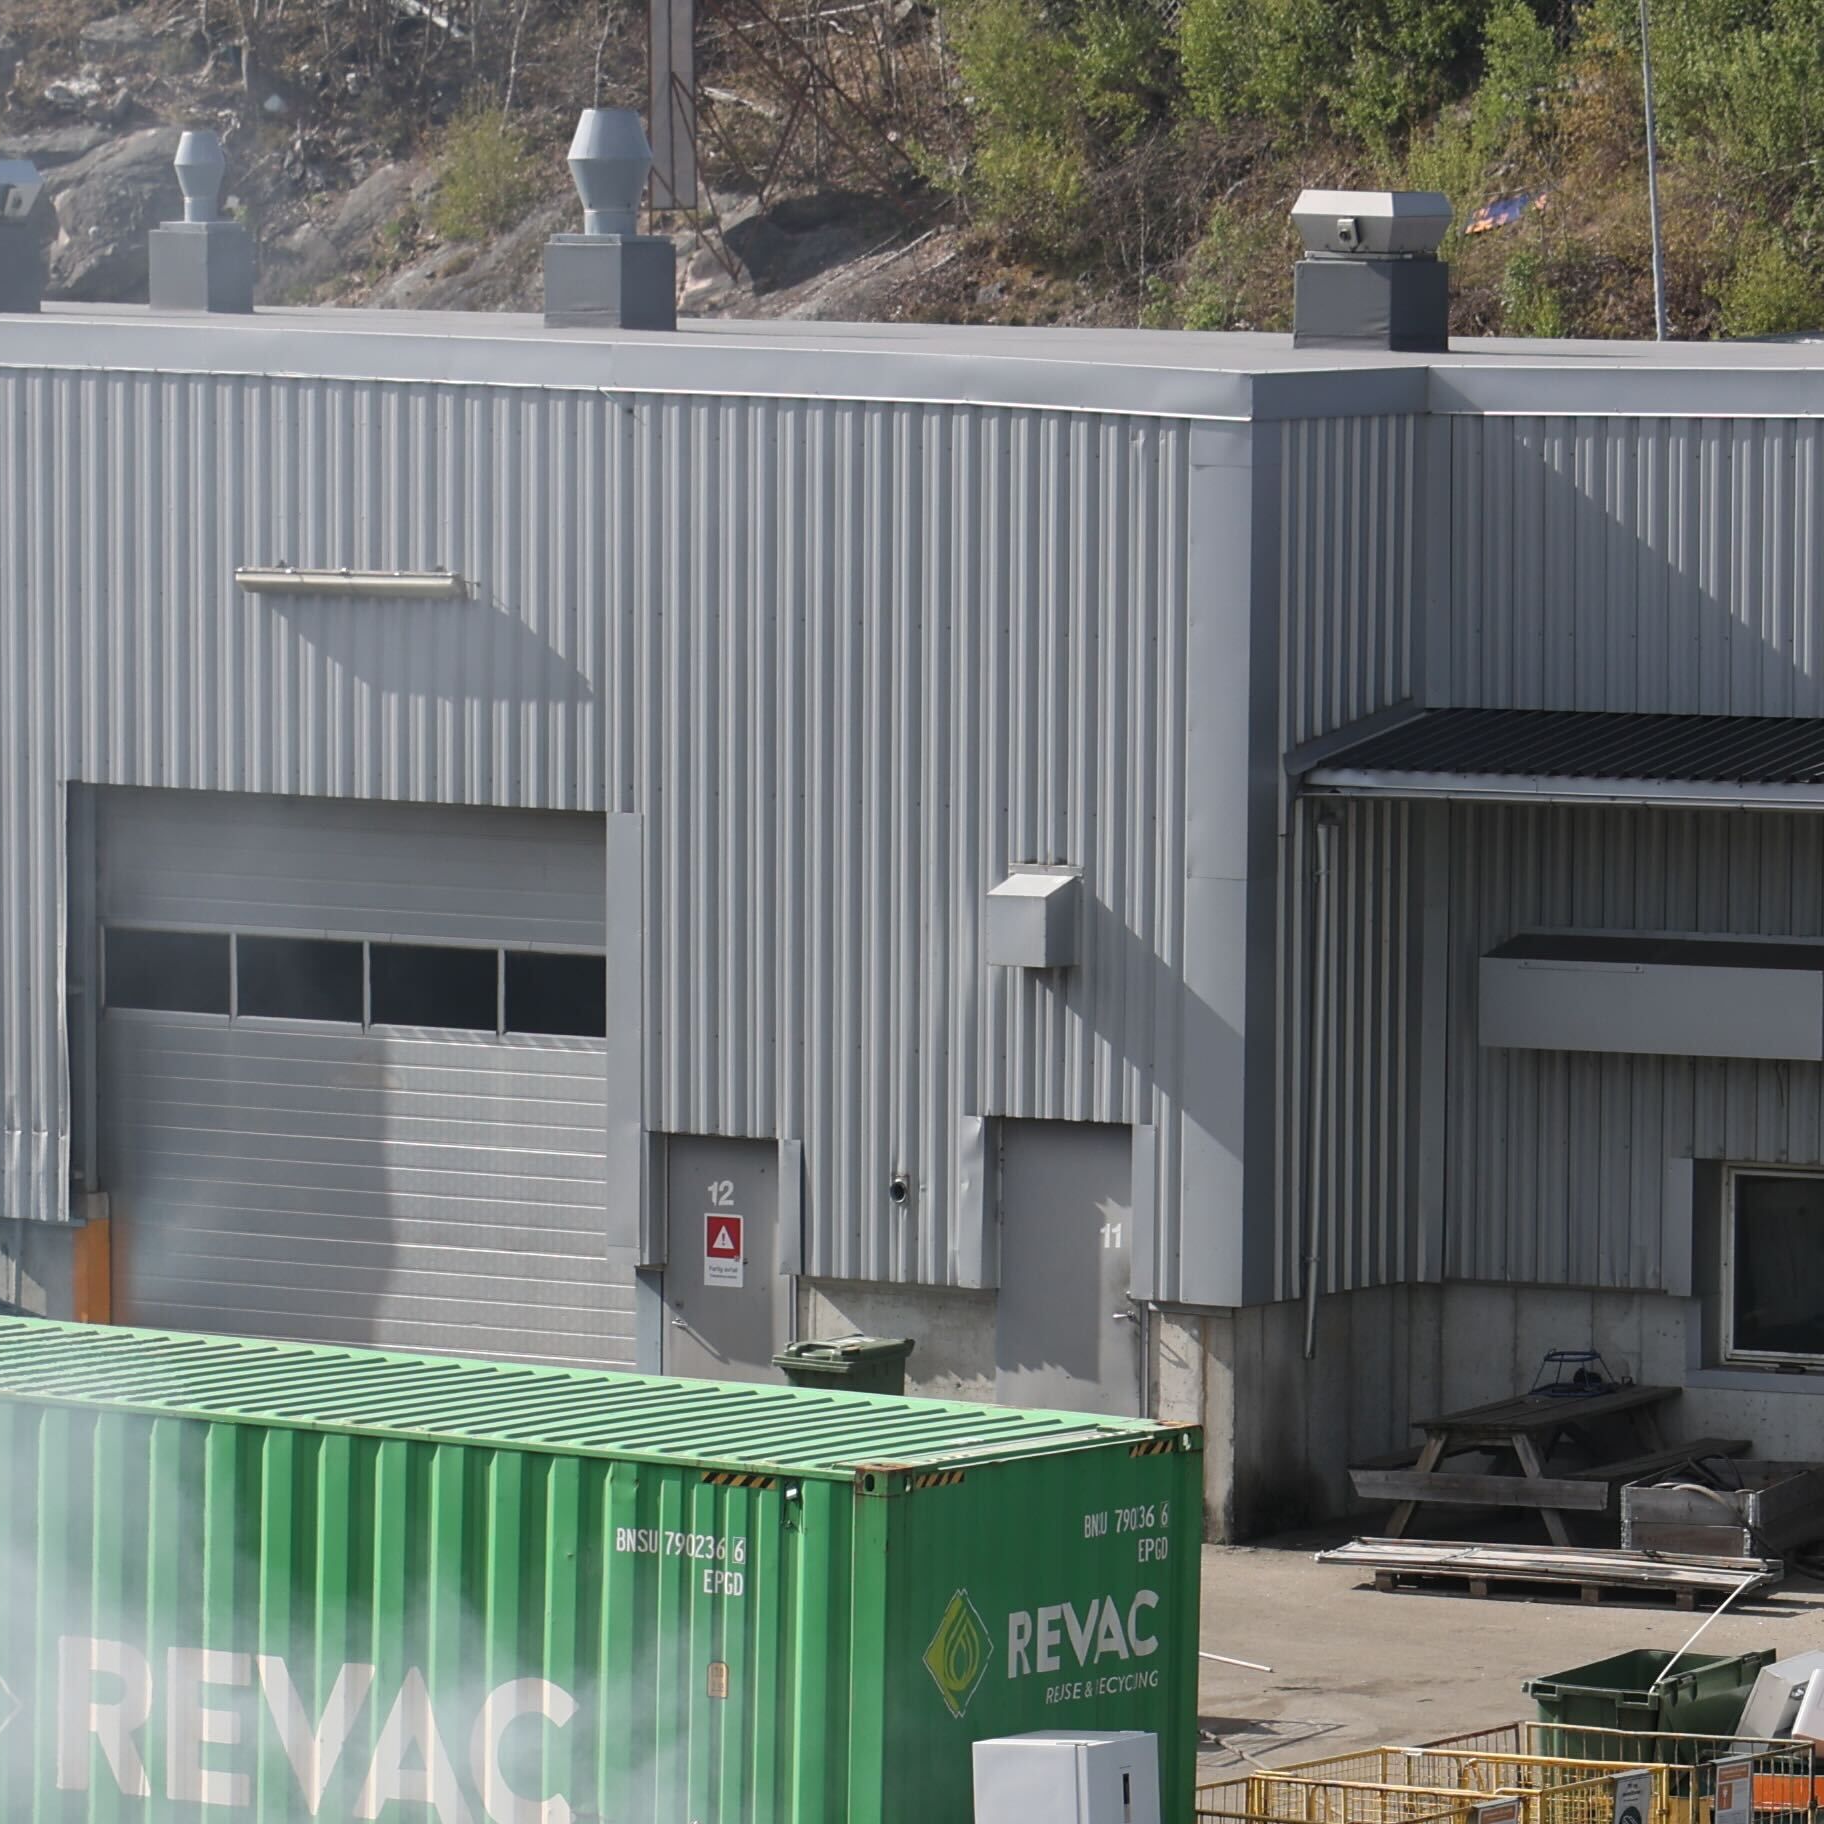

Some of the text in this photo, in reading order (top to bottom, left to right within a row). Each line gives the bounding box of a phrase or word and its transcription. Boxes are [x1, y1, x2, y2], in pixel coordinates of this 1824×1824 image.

[707, 1180, 735, 1206] 12
[1099, 1222, 1123, 1249] 11
[1161, 1502, 1169, 1527] 6
[615, 1527, 745, 1562] BNSU 790236 6
[1138, 1537, 1169, 1563] EPGD
[703, 1569, 744, 1596] EPGD
[1007, 1588, 1160, 1679] REVAC
[1084, 1681, 1093, 1698] &
